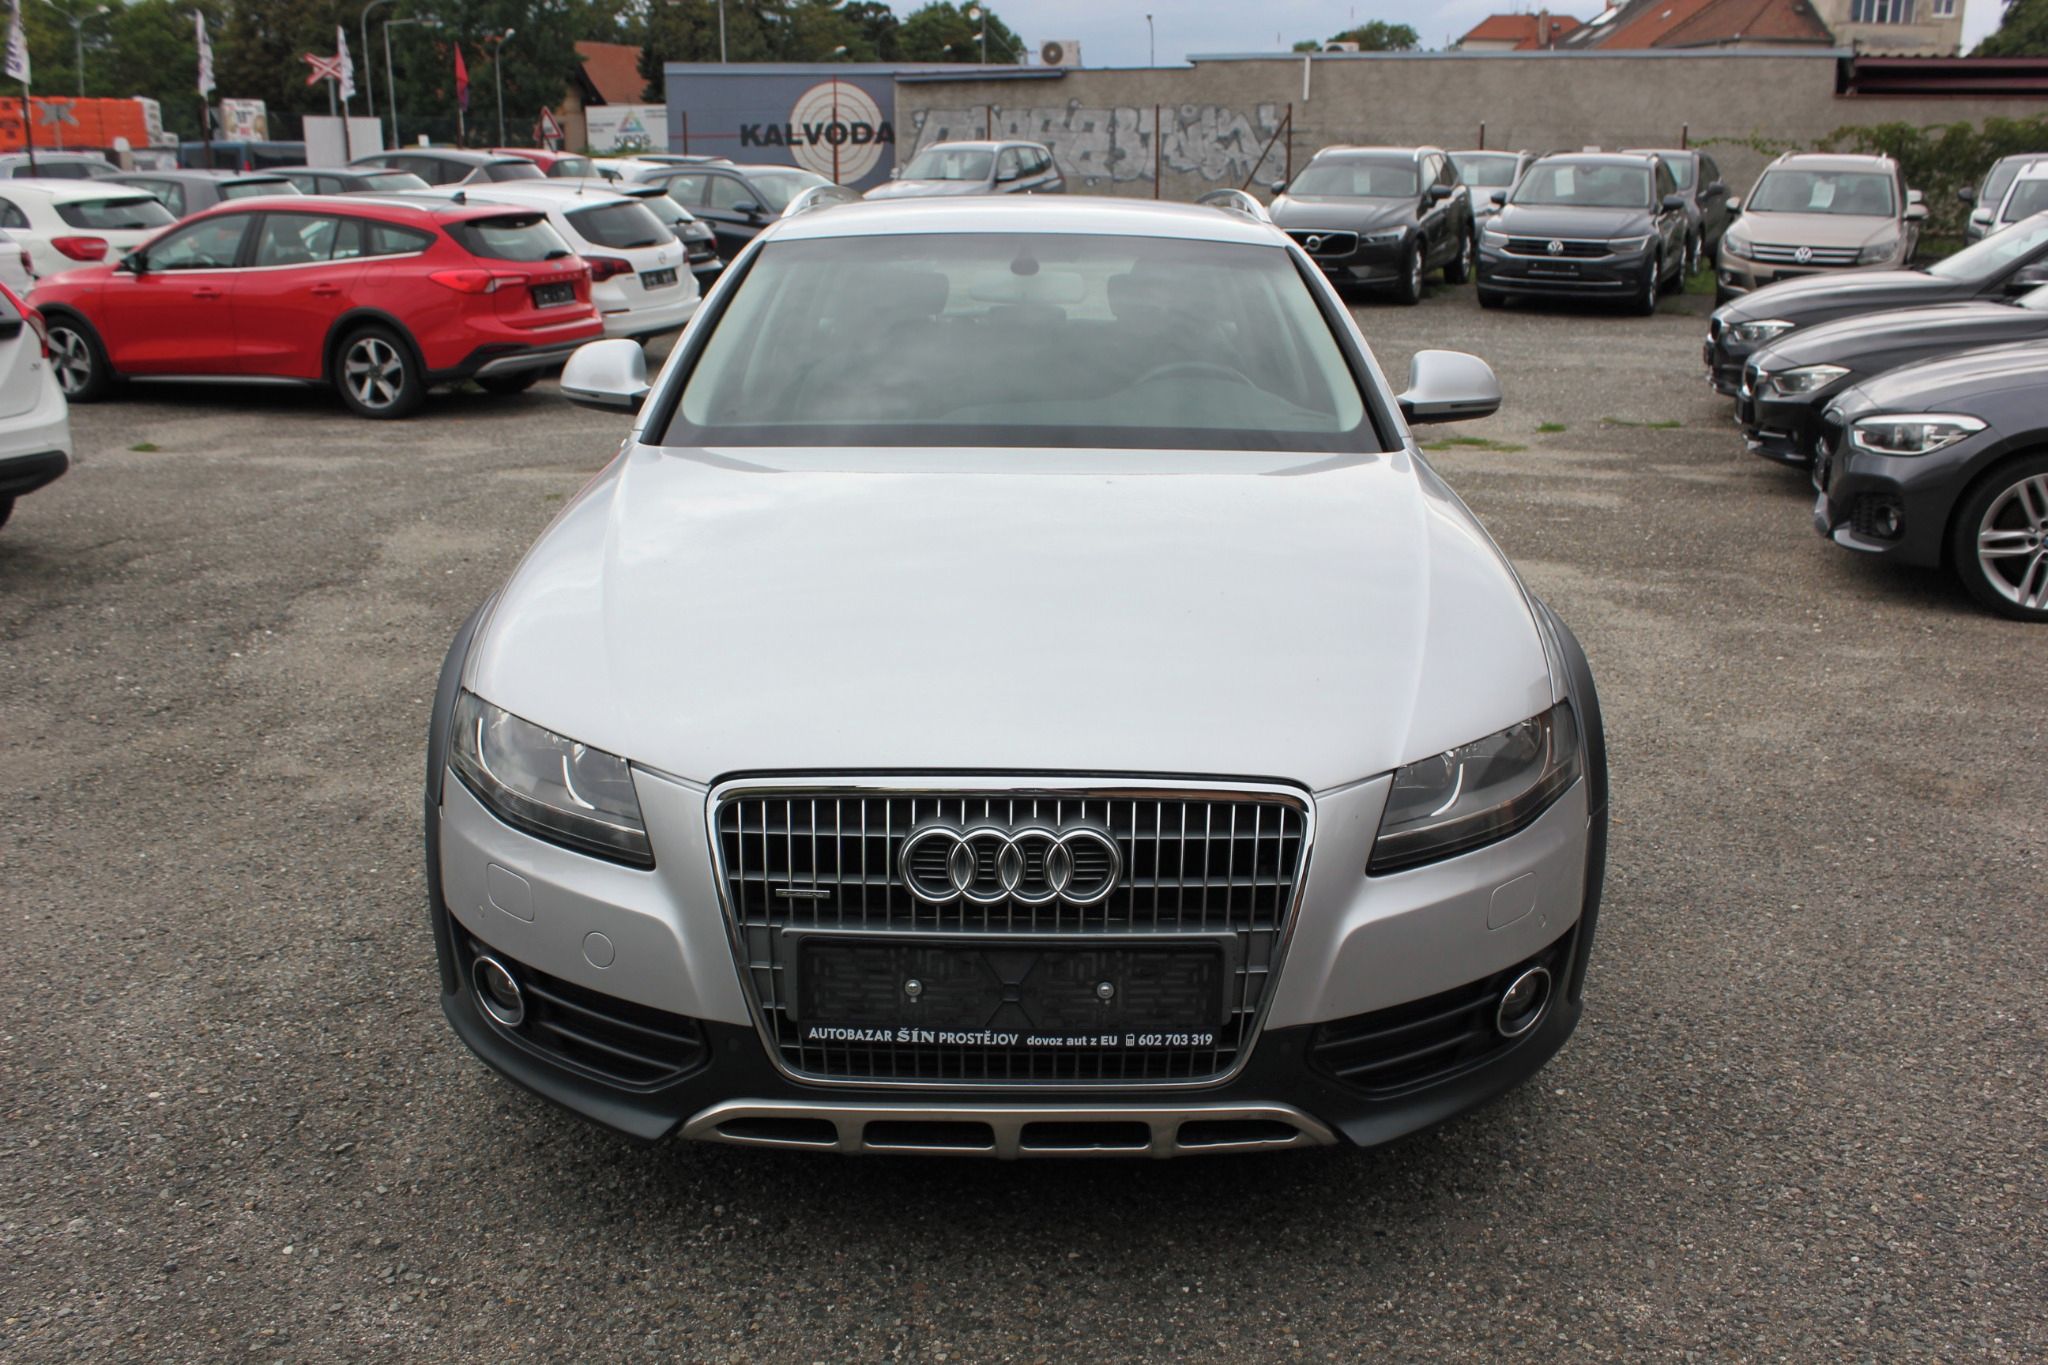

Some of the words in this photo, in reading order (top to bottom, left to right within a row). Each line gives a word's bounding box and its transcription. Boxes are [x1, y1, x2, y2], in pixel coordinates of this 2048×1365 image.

[740, 121, 895, 147] KALVODA
[808, 1027, 892, 1042] AUTOBAZAR
[896, 1027, 935, 1043] ŠÍN
[939, 1030, 1018, 1045] PROSTĚJOV
[1026, 1035, 1063, 1046] dovoz
[1066, 1035, 1087, 1046] aut
[1090, 1037, 1097, 1046] z
[1100, 1035, 1118, 1046] EU
[1138, 1033, 1162, 1046] 602
[1165, 1033, 1188, 1046] 703
[1191, 1033, 1213, 1046] 319
